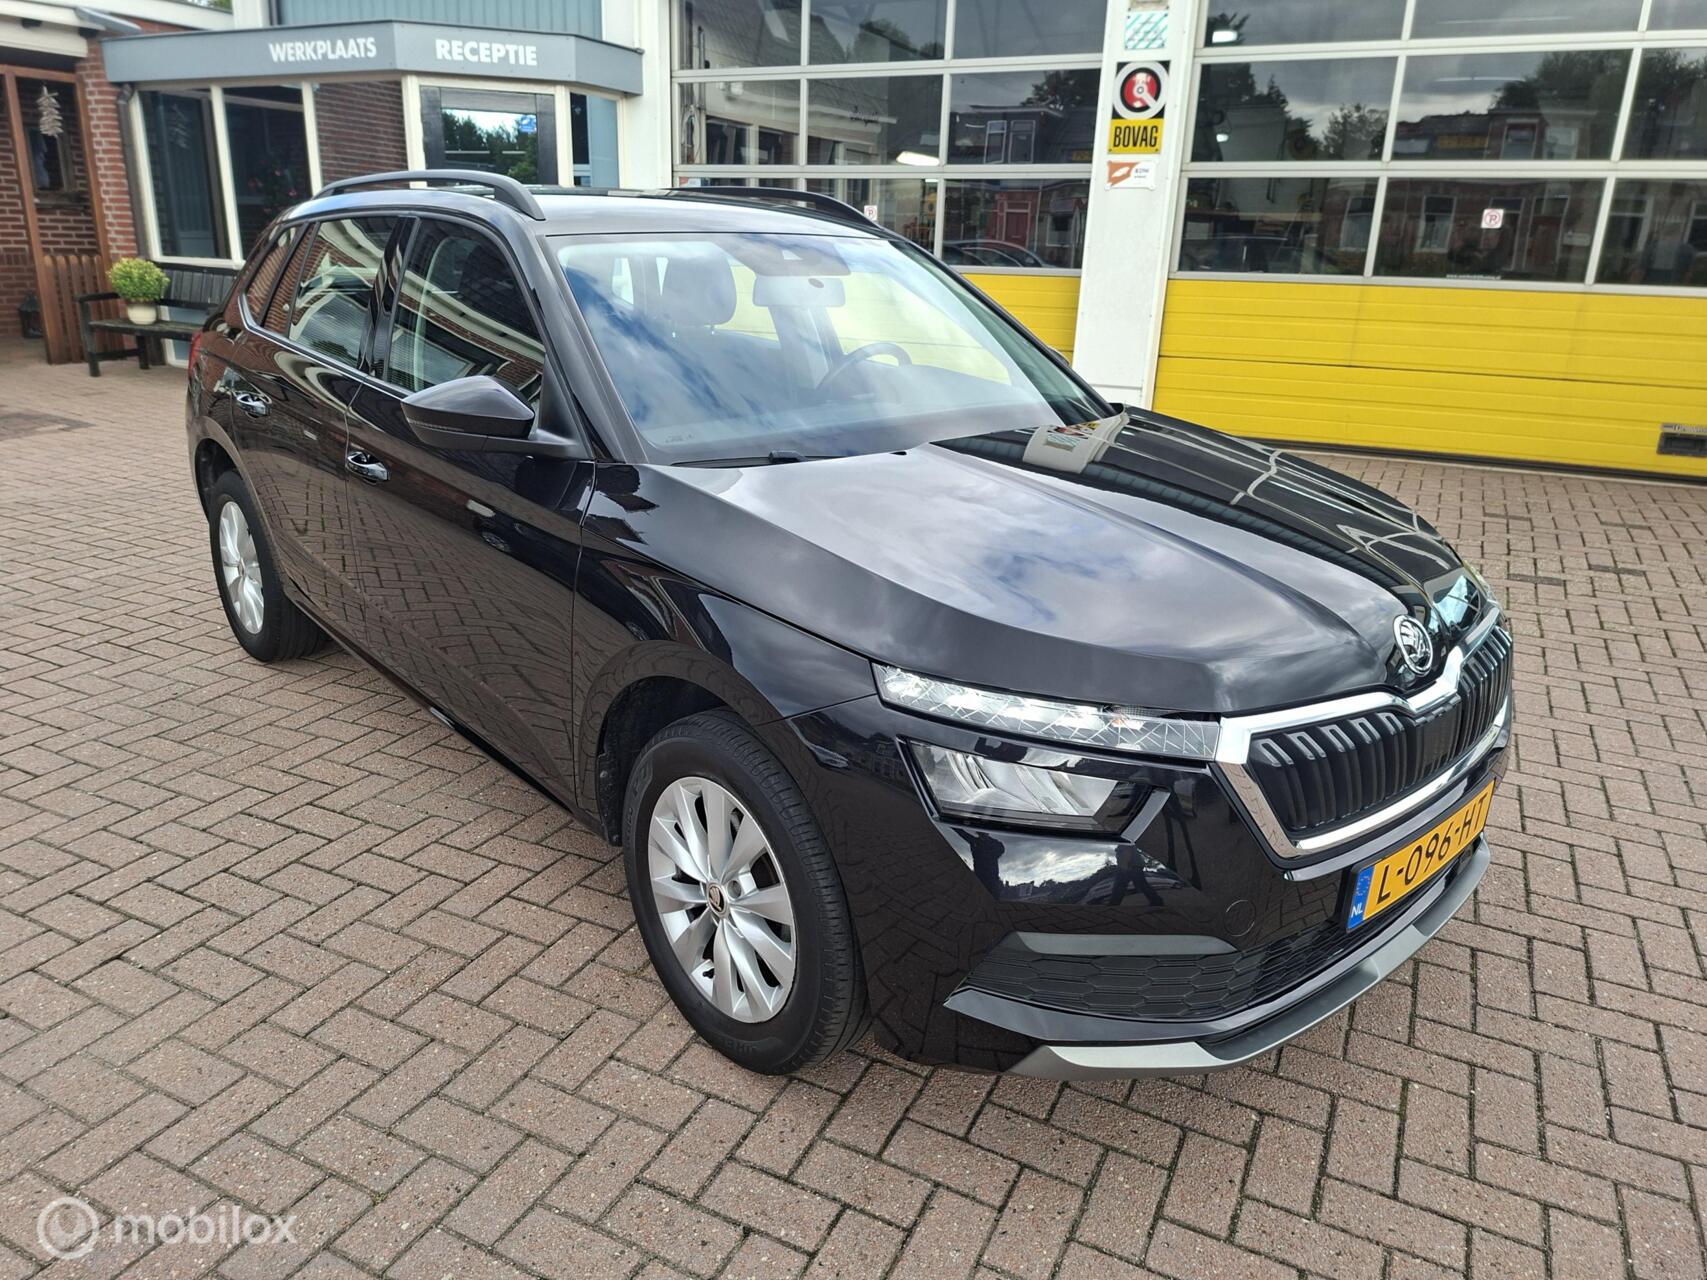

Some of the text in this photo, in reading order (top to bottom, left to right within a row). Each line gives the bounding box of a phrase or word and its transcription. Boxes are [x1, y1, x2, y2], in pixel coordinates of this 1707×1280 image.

[269, 37, 377, 62] WERKPLAATS
[435, 39, 538, 66] RECEPTIE
[1113, 125, 1158, 147] BOVAG
[1376, 792, 1488, 905] L-096-HT
[1351, 902, 1363, 918] NL
